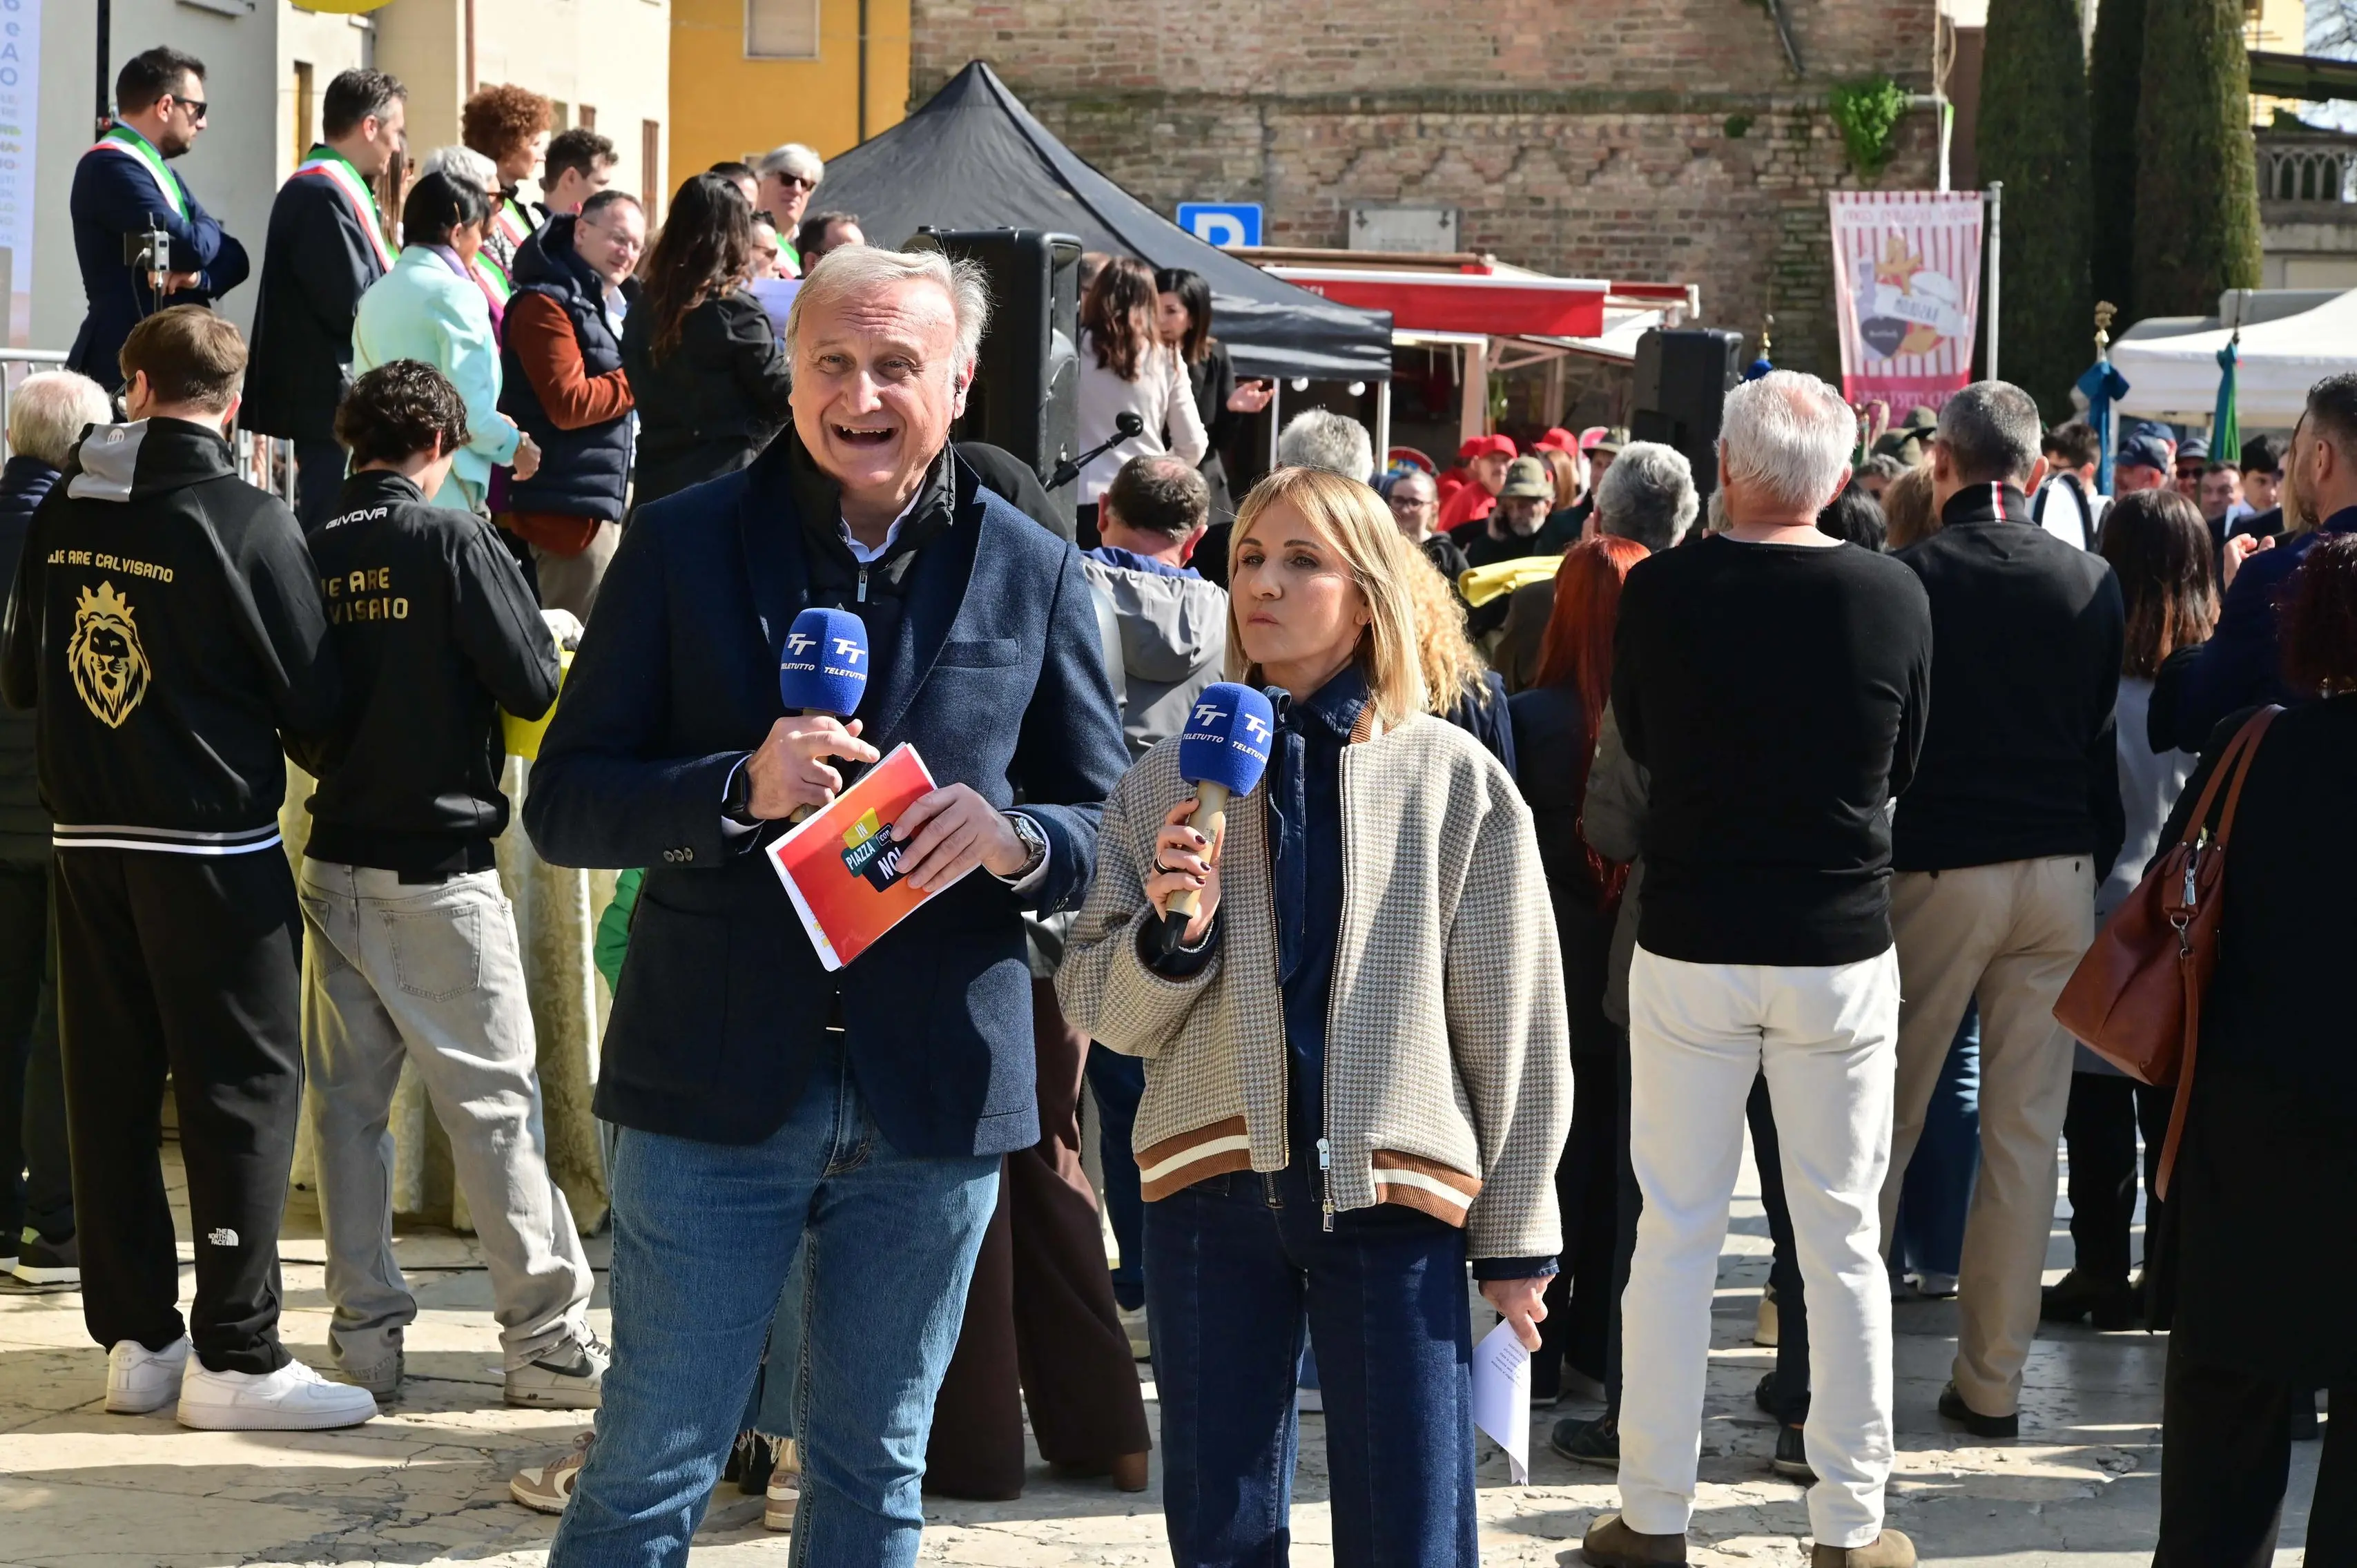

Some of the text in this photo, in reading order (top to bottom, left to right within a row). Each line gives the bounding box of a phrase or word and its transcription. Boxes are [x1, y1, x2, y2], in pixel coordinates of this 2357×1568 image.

[1194, 213, 1245, 247] P
[326, 507, 388, 530] GIVOVA
[68, 550, 93, 565] ARE
[95, 553, 173, 583] CALVISANO
[349, 567, 389, 592] ARE
[824, 666, 866, 681] TELETUTTO
[1182, 733, 1224, 743] TELETUTTO
[855, 822, 869, 838] IN
[845, 840, 876, 870] PIAZZA
